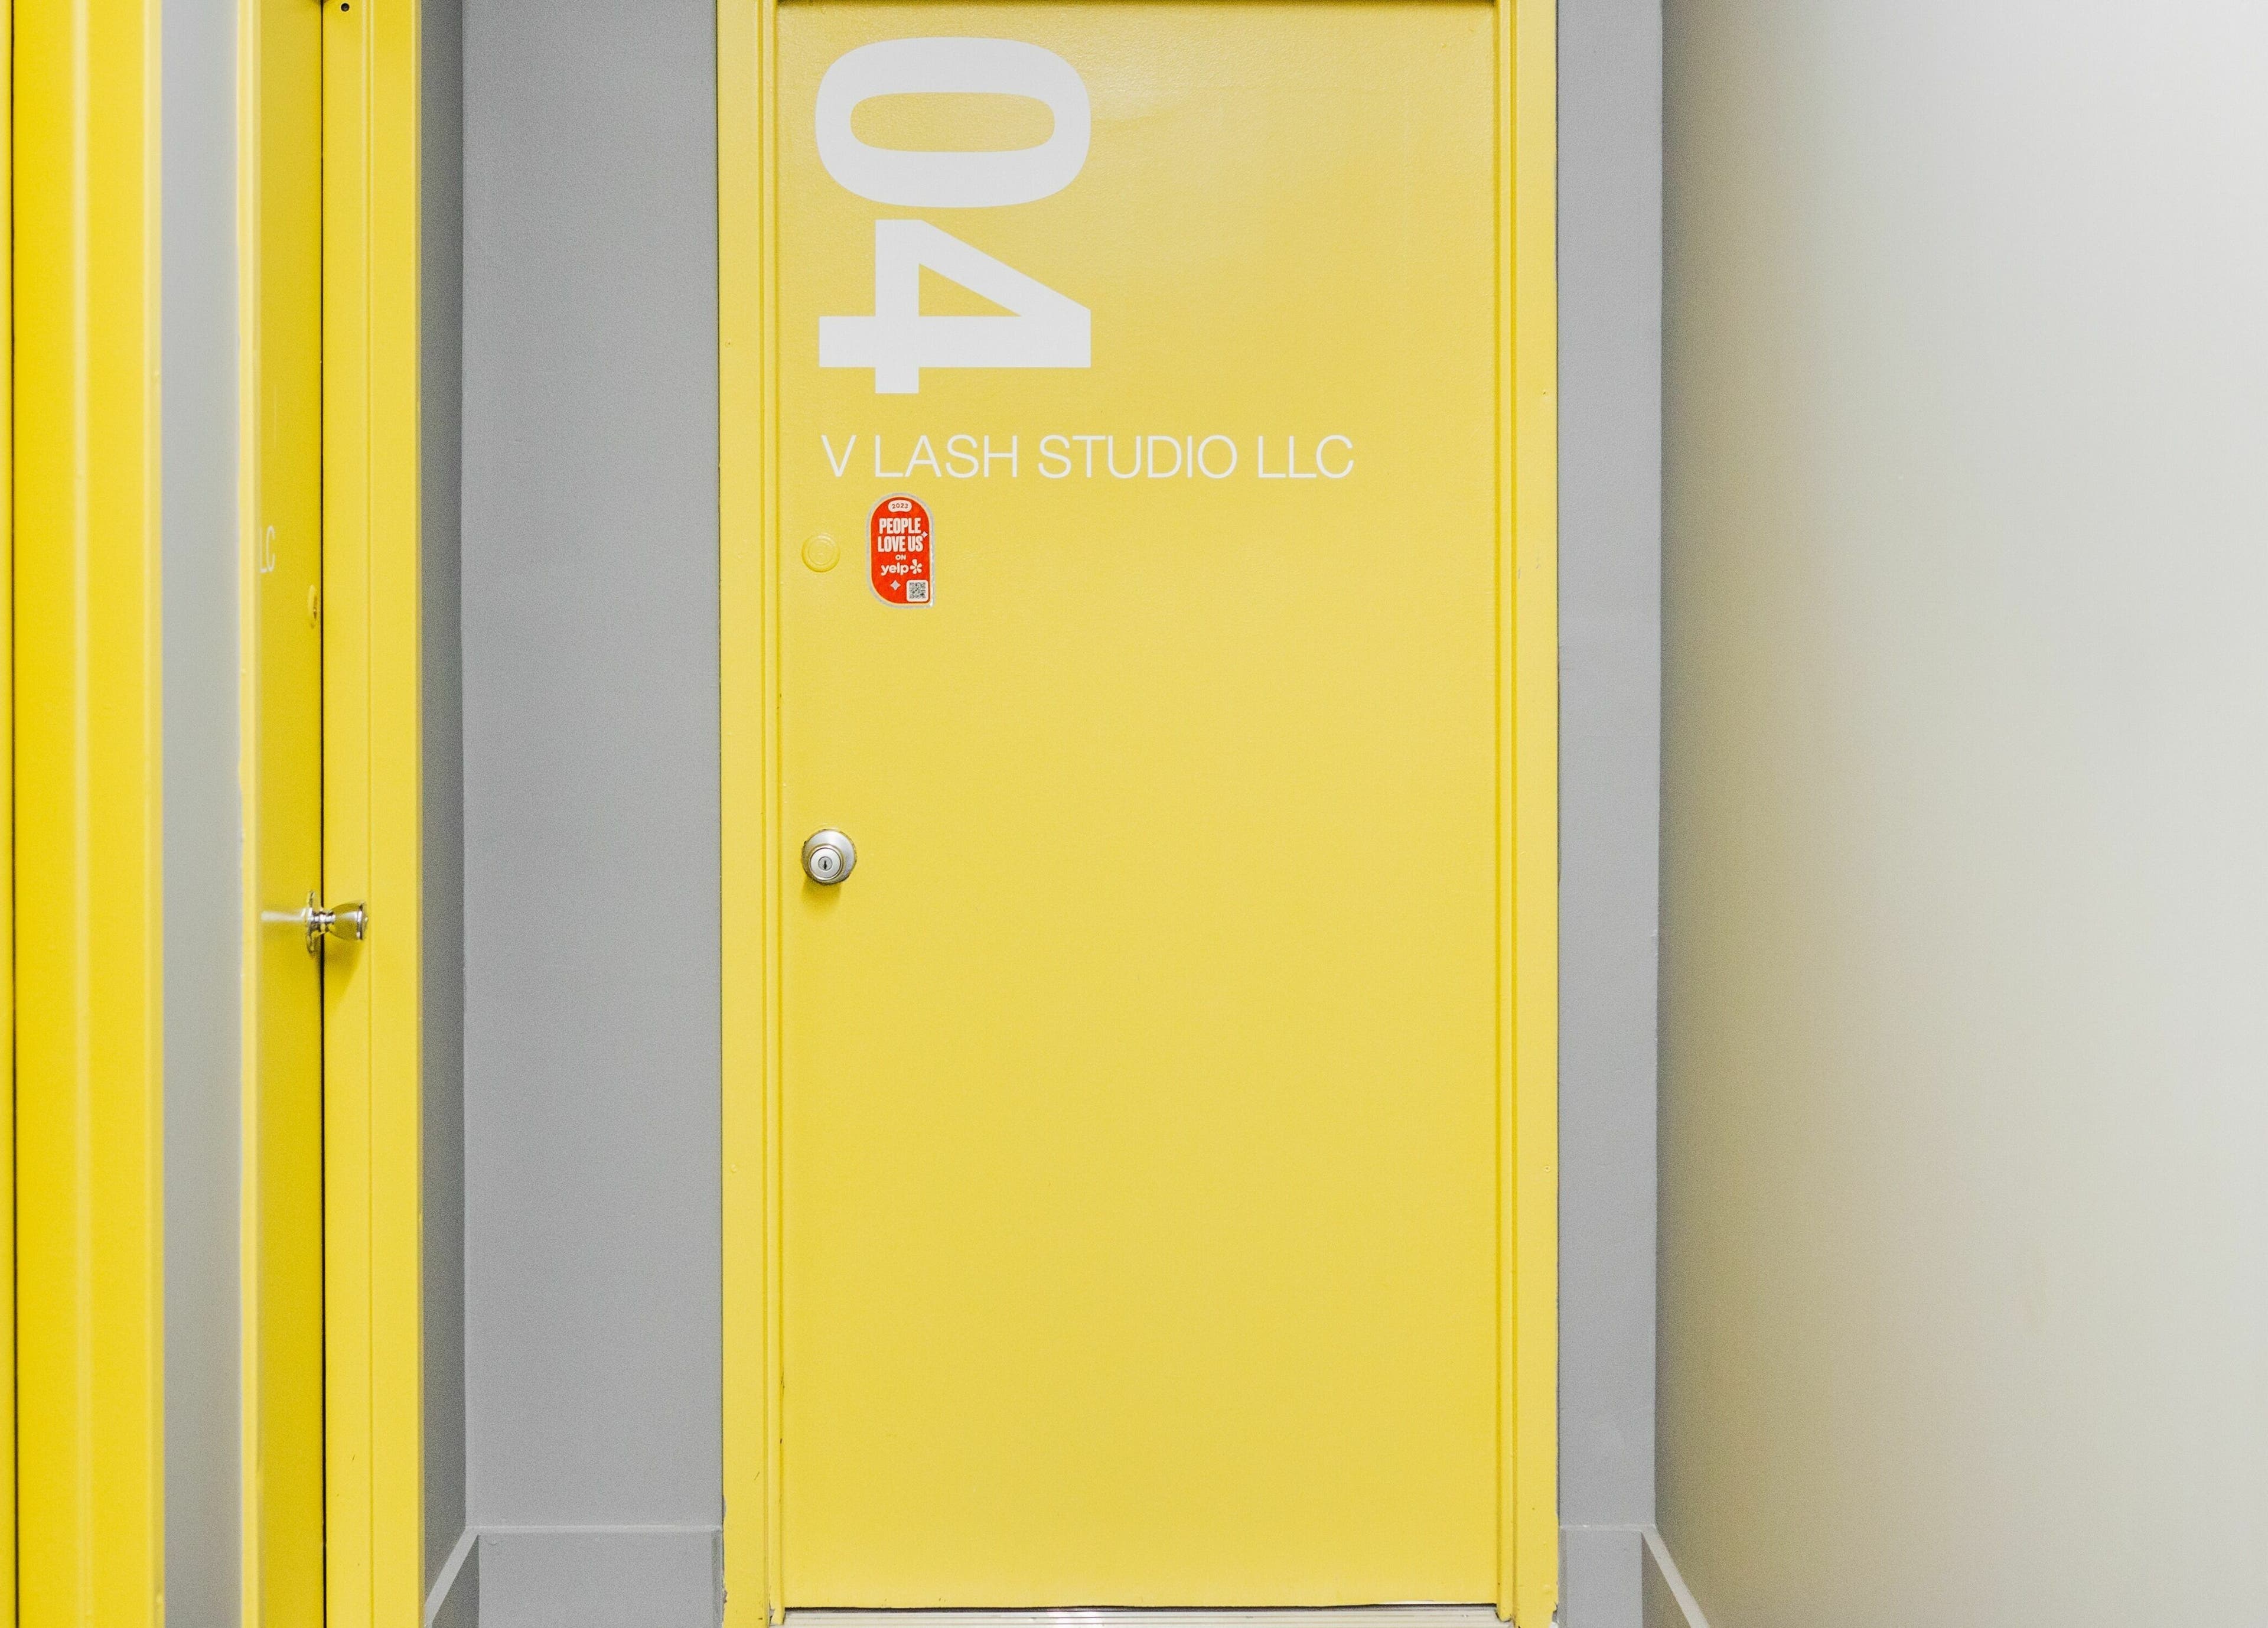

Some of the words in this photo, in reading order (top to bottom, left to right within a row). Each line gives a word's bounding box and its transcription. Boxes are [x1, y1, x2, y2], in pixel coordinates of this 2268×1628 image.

[814, 35, 1092, 394] 04
[821, 434, 856, 478] V
[875, 434, 1018, 479] LASH
[1038, 434, 1238, 479] STUDIO
[1257, 434, 1355, 479] LLC
[879, 517, 921, 535] PEOPLE
[878, 536, 905, 552] LOVE
[908, 535, 923, 552] US
[881, 562, 910, 576] yelp
